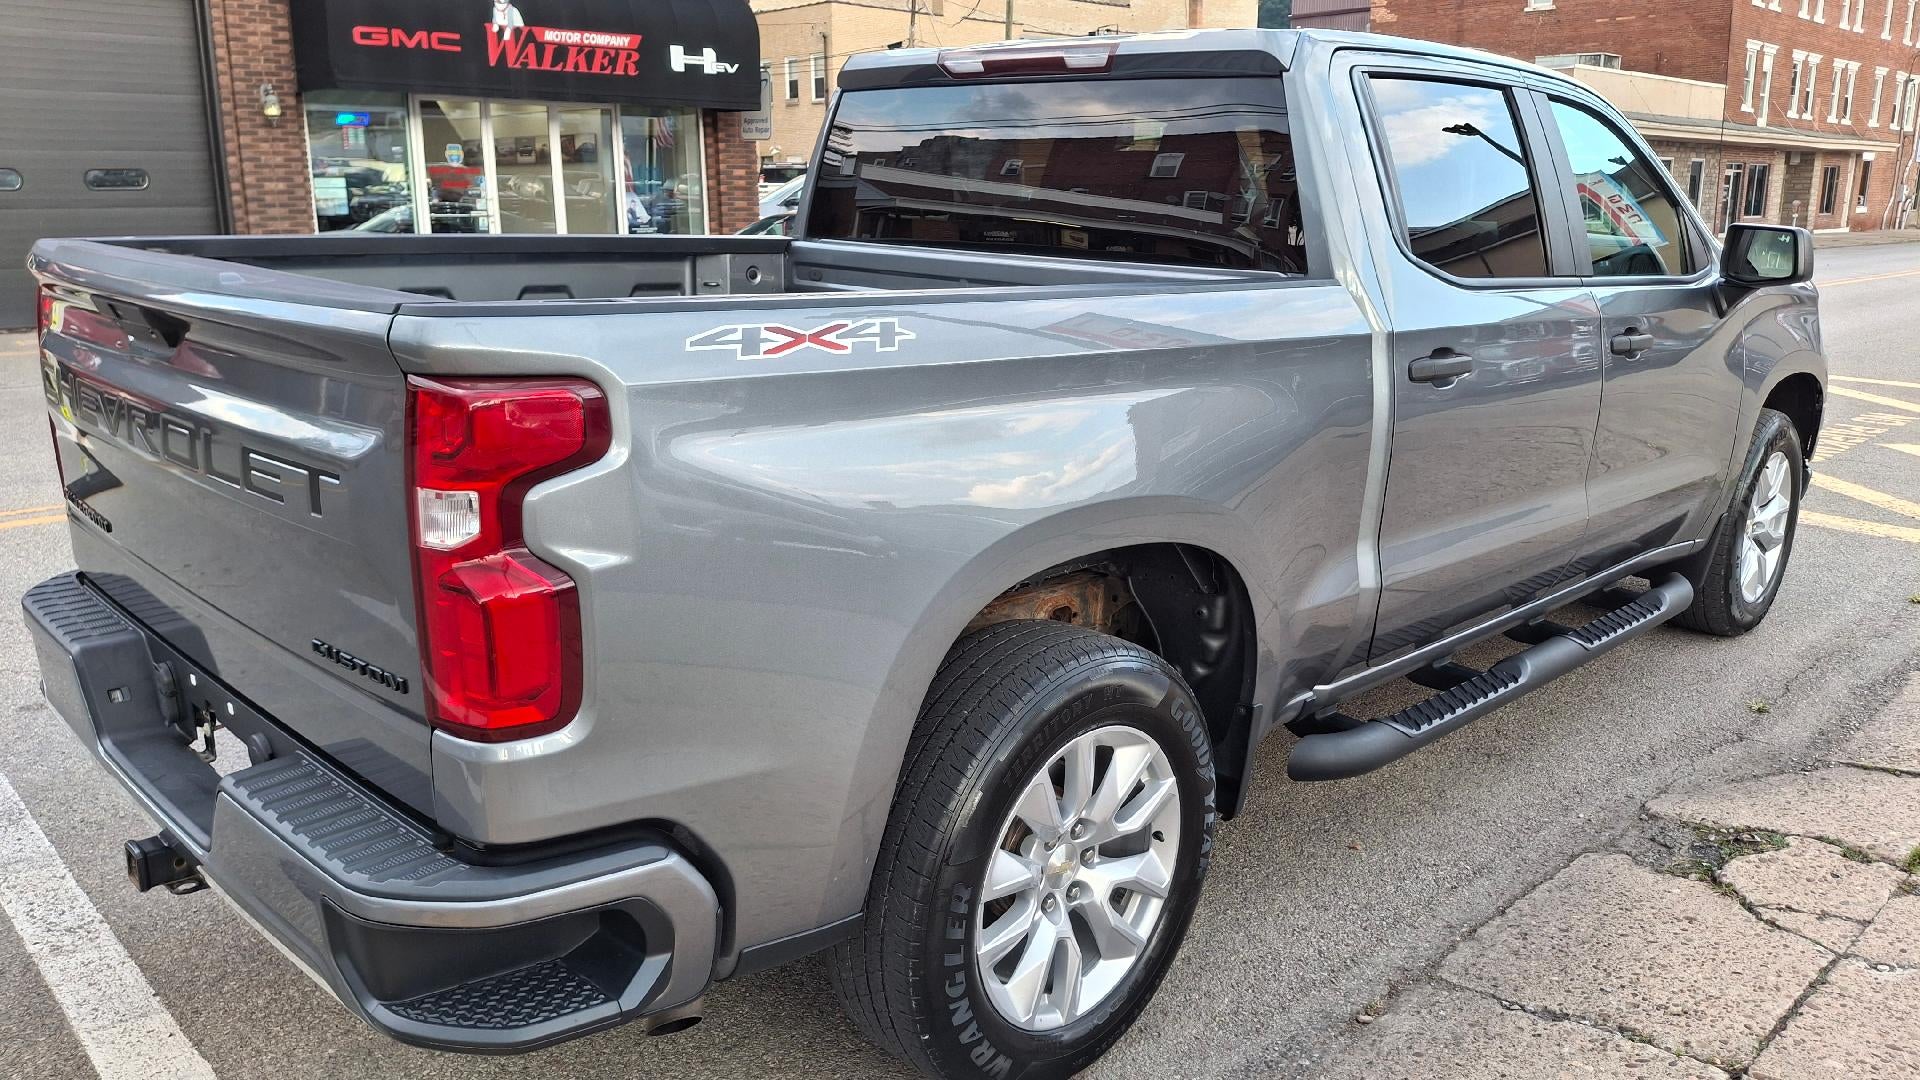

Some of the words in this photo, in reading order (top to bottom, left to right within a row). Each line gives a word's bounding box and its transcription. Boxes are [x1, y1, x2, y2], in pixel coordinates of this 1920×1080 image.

[352, 25, 462, 52] GMC
[484, 23, 641, 76] WALKER
[544, 30, 582, 44] MOTOR
[582, 32, 631, 47] COMPANY
[43, 364, 340, 518] CHEVROLET
[311, 638, 409, 694] CUSTOM
[1169, 694, 1217, 882] GOODYEAR
[943, 882, 1014, 1080] WRANGLER
